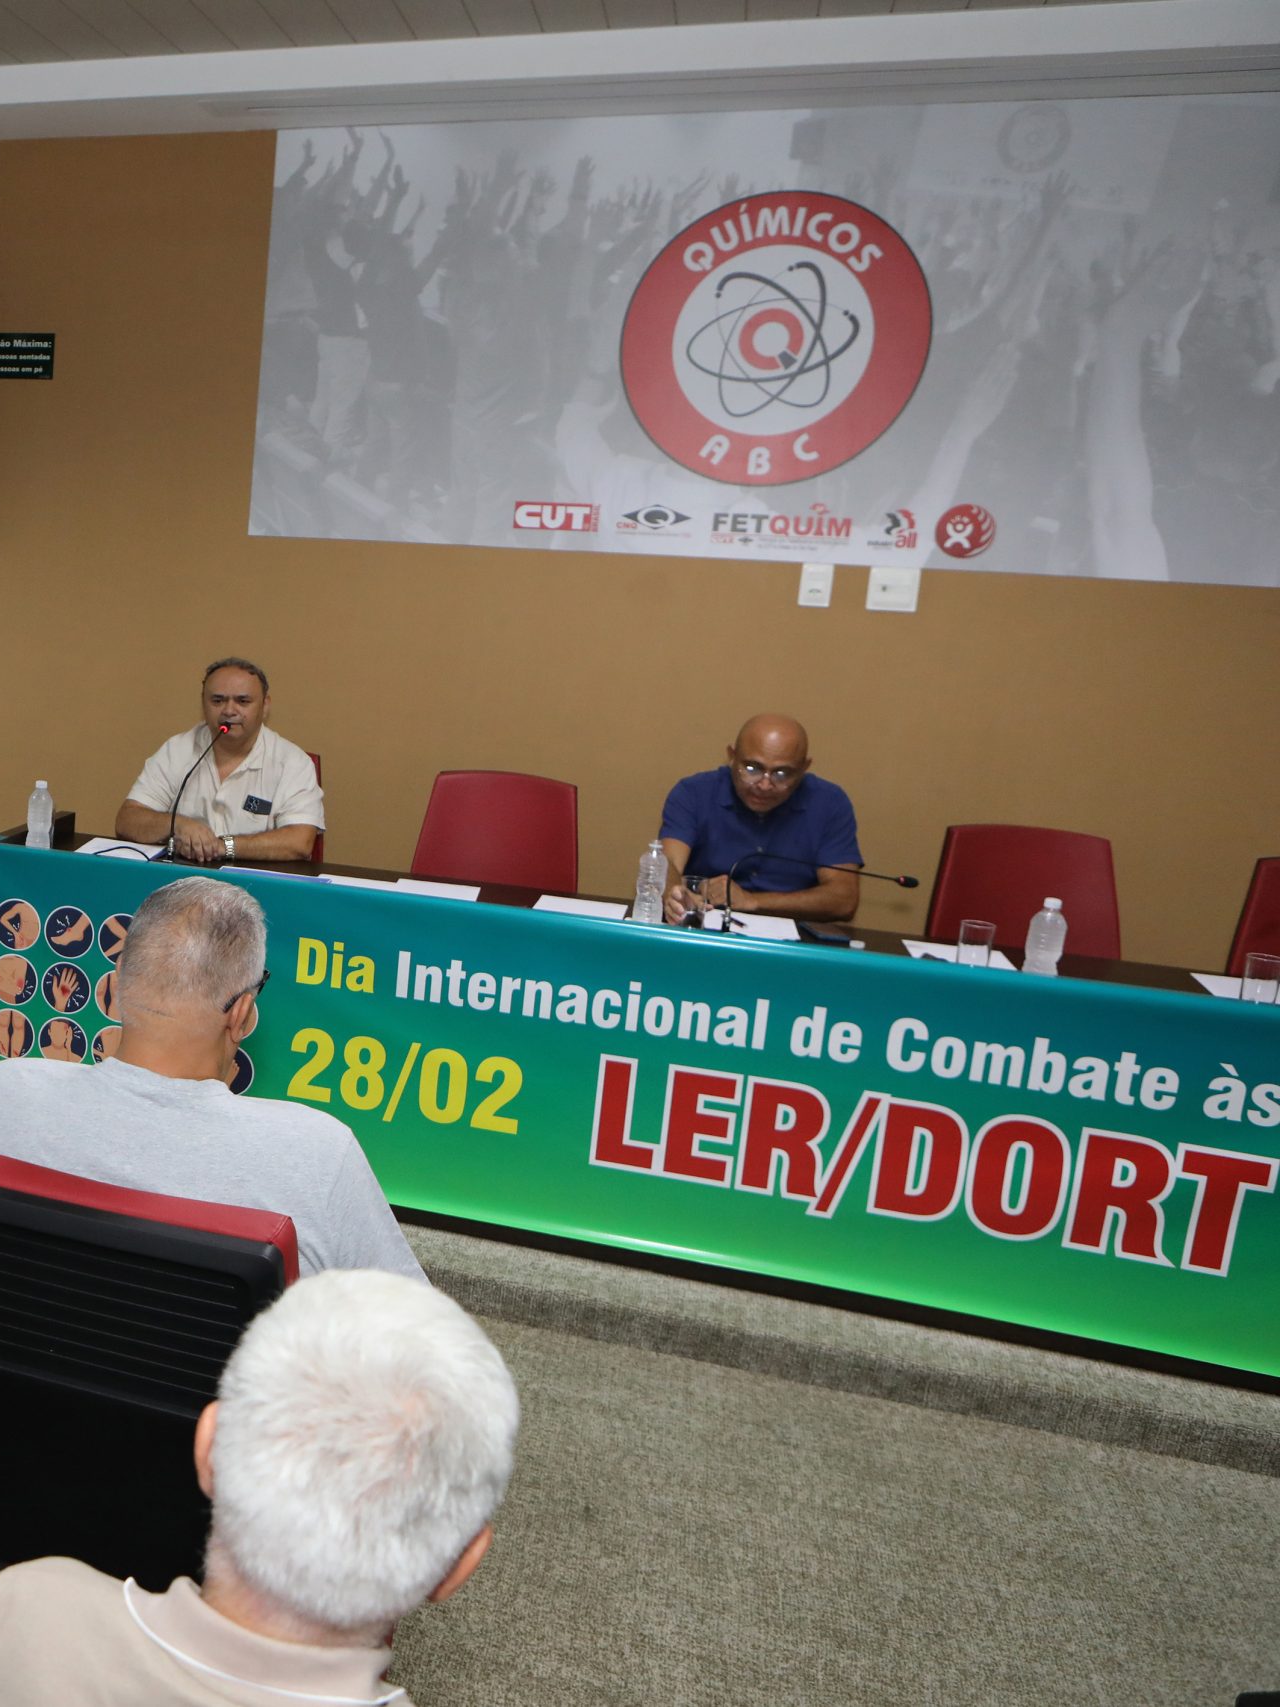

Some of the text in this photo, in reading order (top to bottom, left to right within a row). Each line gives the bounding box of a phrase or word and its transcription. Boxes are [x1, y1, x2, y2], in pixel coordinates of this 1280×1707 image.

[683, 203, 884, 273] QUÍMICOS
[13, 339, 52, 348] Máxima:
[19, 353, 51, 361] sentadas
[515, 504, 591, 530] CUT
[295, 936, 1280, 1127] Dia Internacional de Combate às
[286, 1026, 524, 1135] 28/02
[589, 1054, 1280, 1278] LER/DORT
